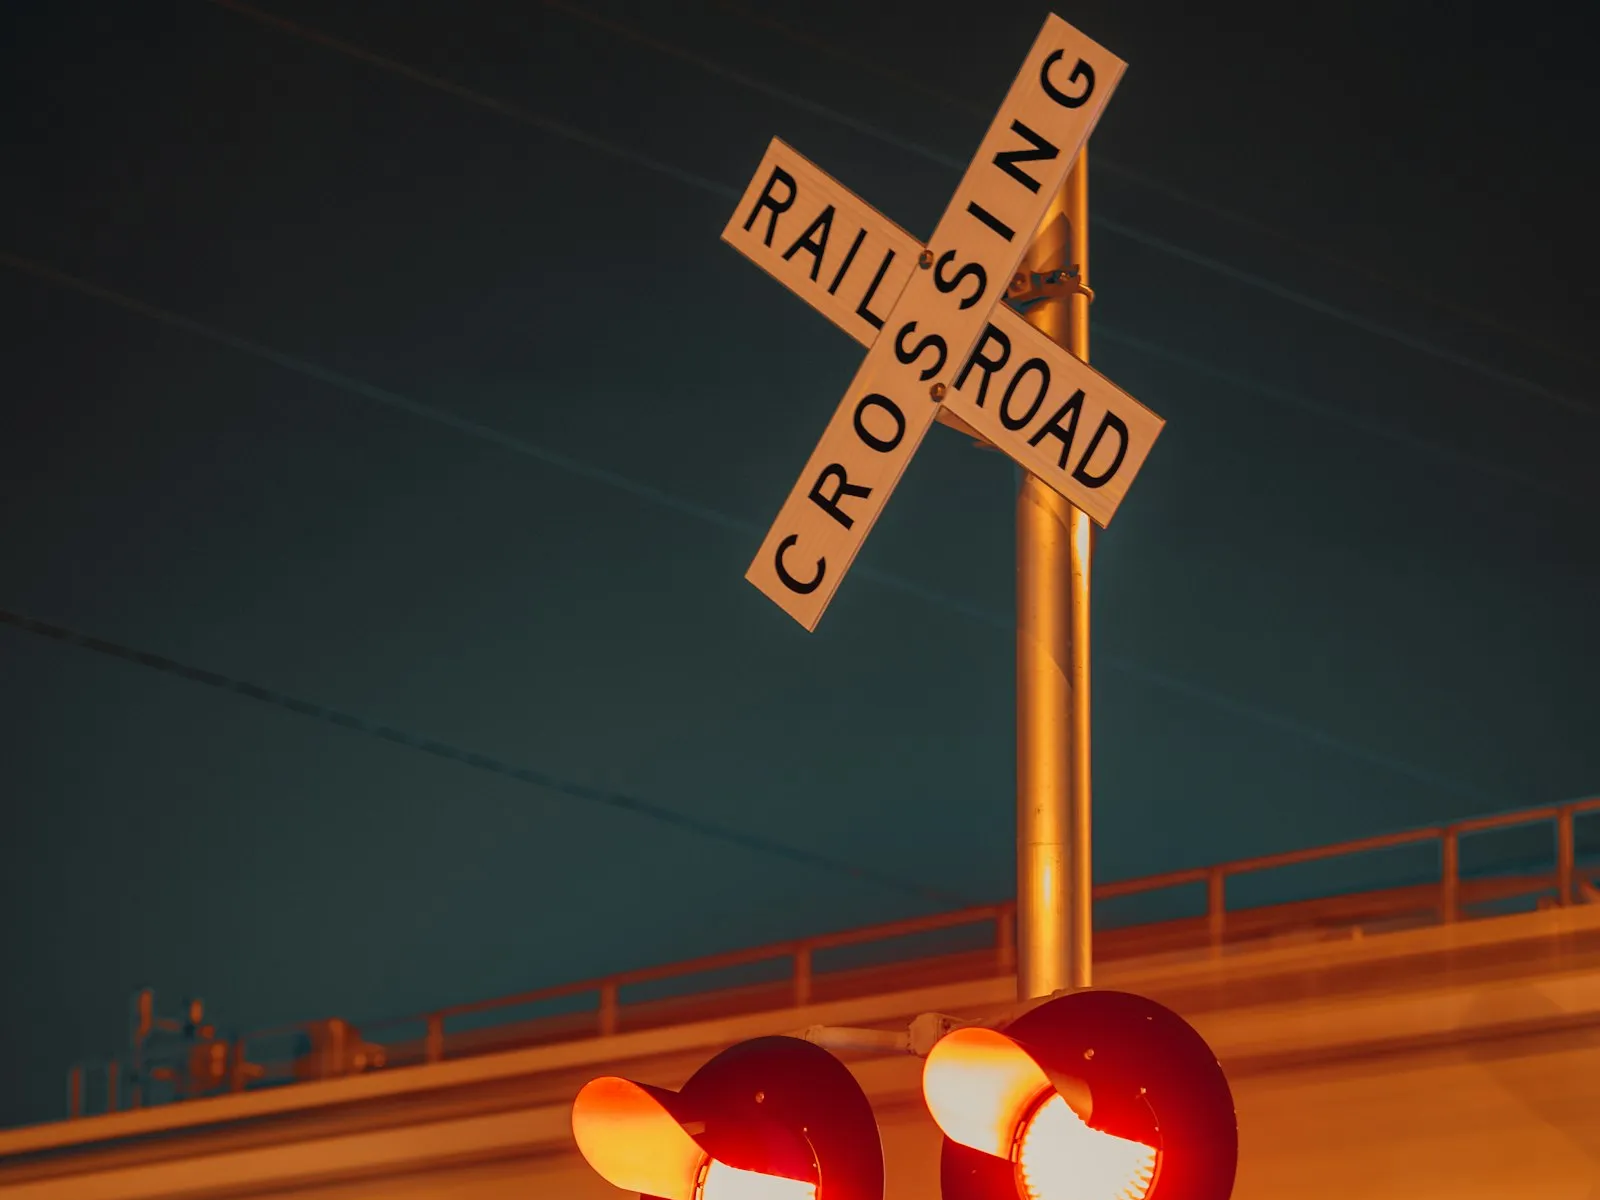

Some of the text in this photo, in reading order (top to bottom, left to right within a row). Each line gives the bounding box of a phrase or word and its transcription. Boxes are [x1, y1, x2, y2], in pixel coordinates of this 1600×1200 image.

[742, 166, 1129, 490] RAIL ROAD
[774, 48, 1096, 595] CROSSING
